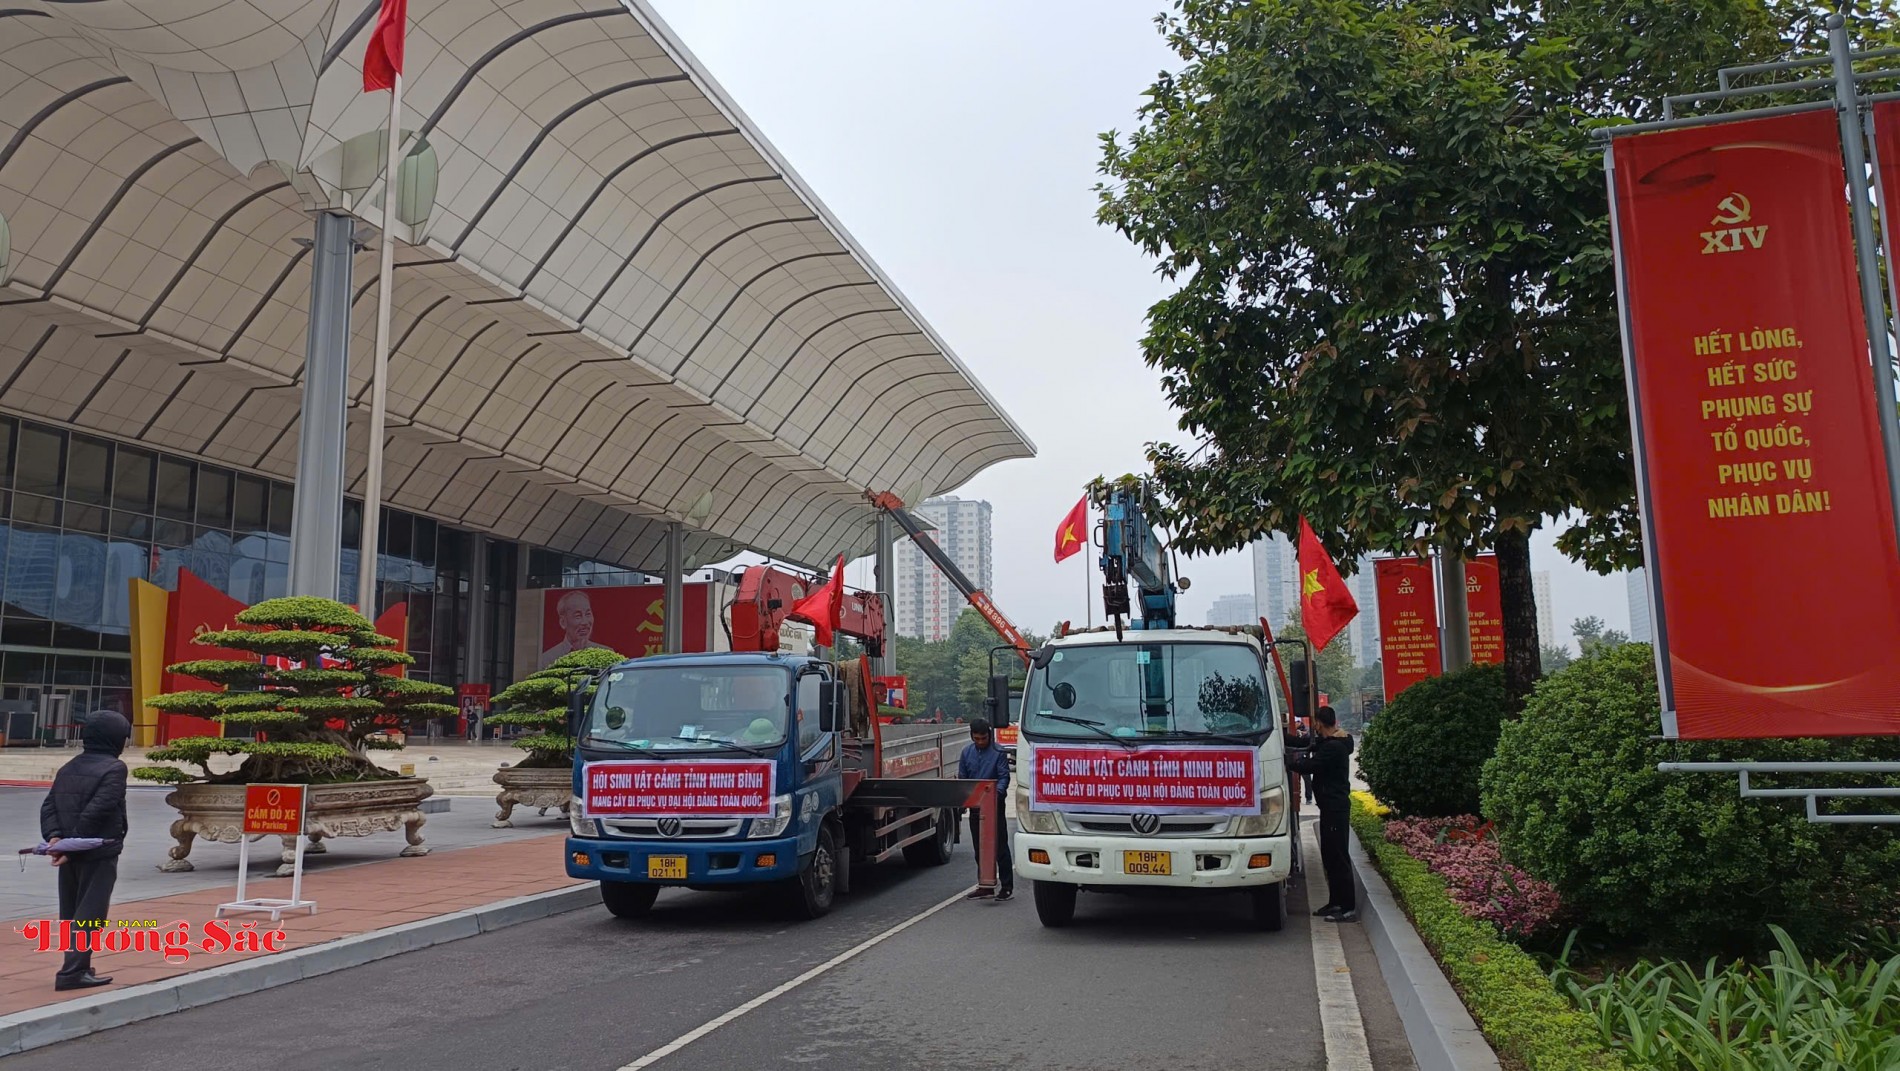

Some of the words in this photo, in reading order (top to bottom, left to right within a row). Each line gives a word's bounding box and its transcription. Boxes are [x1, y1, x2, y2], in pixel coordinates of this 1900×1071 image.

[1699, 225, 1769, 255] XIV
[1694, 328, 1733, 356] HẾT
[1739, 326, 1803, 351] LÒNG,
[1707, 359, 1746, 387] HẾT
[1753, 357, 1798, 383] SỨC
[1701, 395, 1776, 422] PHỤNG
[1783, 390, 1814, 416] SỰ
[1711, 422, 1738, 452] TỔ
[1744, 420, 1811, 451] QUỐC,
[1718, 462, 1777, 486] PHỤC
[1783, 458, 1812, 484] VỤ
[1708, 492, 1770, 518] NHÂN
[1776, 489, 1831, 515] DÂN!
[1398, 586, 1415, 594] XIV
[1042, 756, 1060, 779] HỘI
[1063, 760, 1090, 777] SINH
[1093, 756, 1114, 780] VẬT
[1117, 755, 1150, 778] CẢNH
[1152, 755, 1180, 778] TỈNH
[1183, 760, 1213, 778] NINH
[1216, 757, 1246, 779] BÌNH
[592, 770, 608, 792] HỘI
[610, 773, 632, 789] SINH
[634, 770, 652, 792] VẬT
[654, 768, 680, 789] CẢNH
[684, 768, 706, 789] TỈNH
[709, 772, 735, 789] NINH
[738, 769, 763, 789] BÌNH
[1042, 783, 1066, 796] MANG
[1068, 781, 1084, 796] CÂY
[1086, 783, 1096, 797] ĐI
[1098, 784, 1120, 800] PHỤC
[1122, 784, 1134, 800] VỤ
[1136, 784, 1151, 800] ĐẠI
[1153, 782, 1168, 800] HỘI
[1170, 781, 1194, 799] ĐẢNG
[1196, 782, 1220, 799] TOÀN
[1222, 781, 1246, 800] QUỐC
[613, 793, 626, 808] CÂY
[628, 796, 636, 808] ĐI
[636, 795, 656, 810] PHỤC
[658, 795, 667, 810] VỤ
[668, 796, 681, 810] ĐẠI
[682, 792, 695, 810] HỘI
[696, 792, 718, 808] ĐẢNG
[720, 792, 740, 808] TOÀN
[742, 790, 763, 808] QUỐC
[252, 820, 260, 829] No
[262, 820, 288, 830] Parking
[284, 809, 296, 820] XE
[660, 858, 676, 868] 18H
[1129, 862, 1166, 874] 009.44
[1139, 852, 1158, 862] 18H
[652, 868, 682, 878] 021.11
